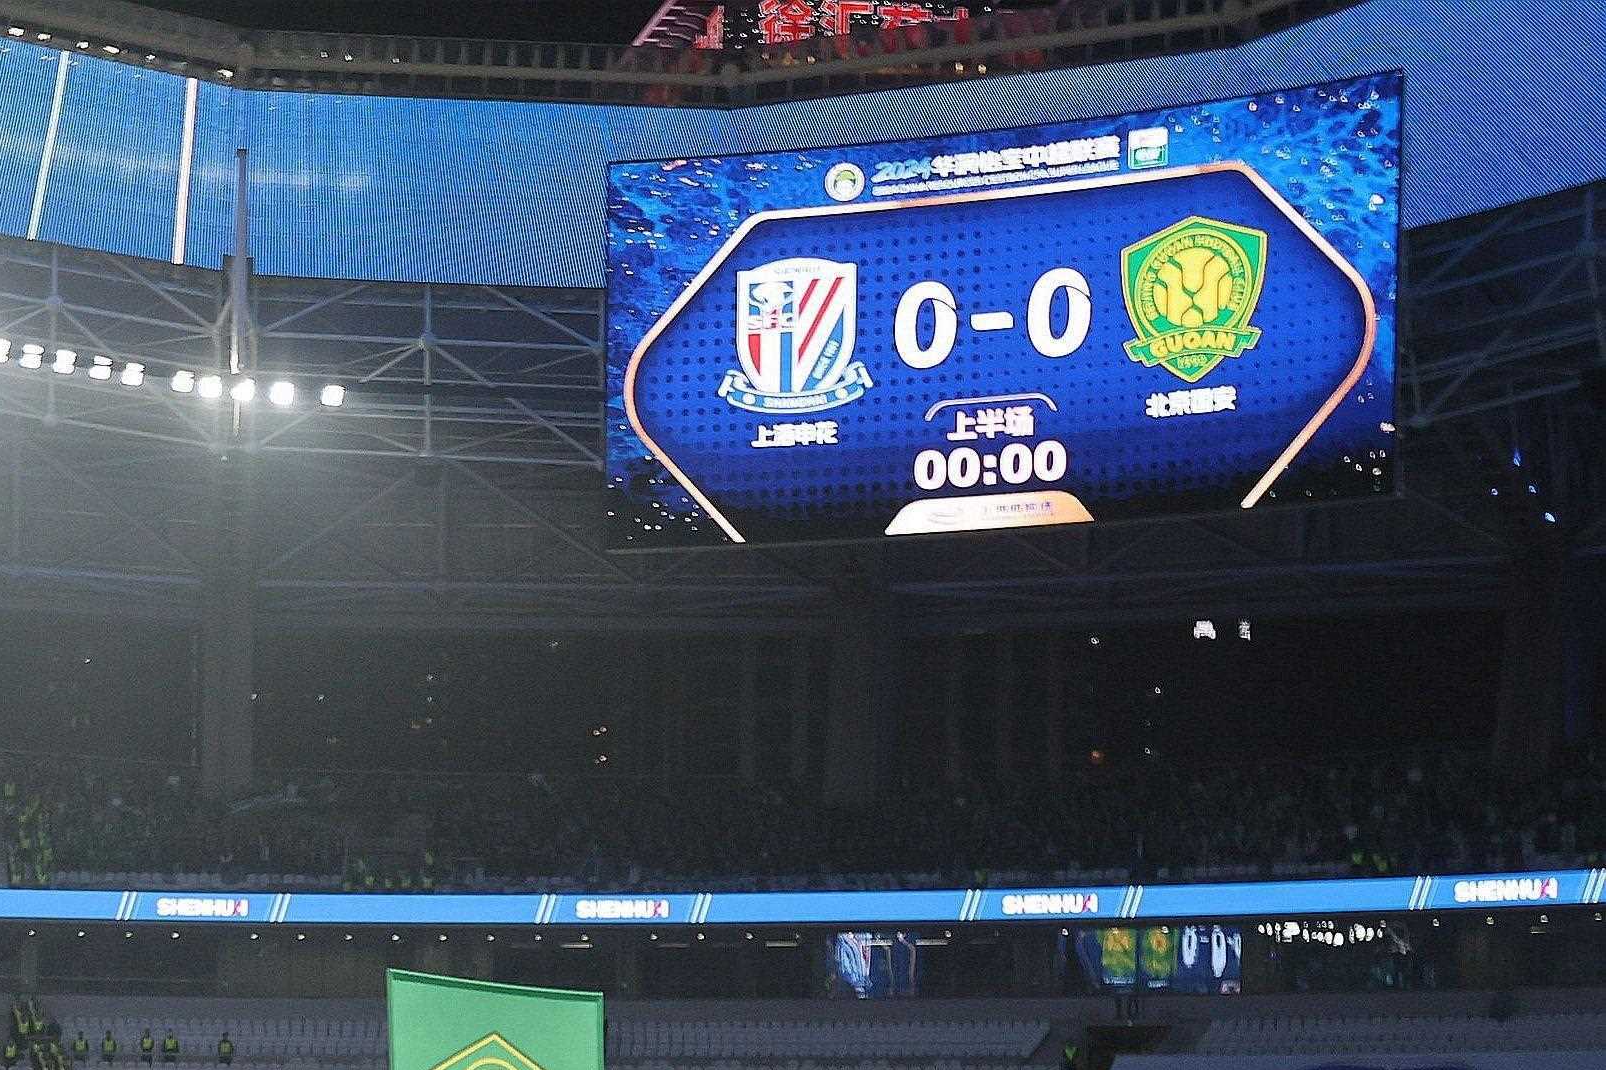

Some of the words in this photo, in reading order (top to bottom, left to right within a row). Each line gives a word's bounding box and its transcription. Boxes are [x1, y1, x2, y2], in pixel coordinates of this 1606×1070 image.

[947, 406, 1034, 441] 上半场
[914, 440, 1067, 490] 00:00
[1454, 878, 1558, 902] SHENHUA
[157, 898, 249, 916] SHENHUA
[575, 900, 669, 918] SHENHUA
[1002, 894, 1098, 914] SHENHUA
